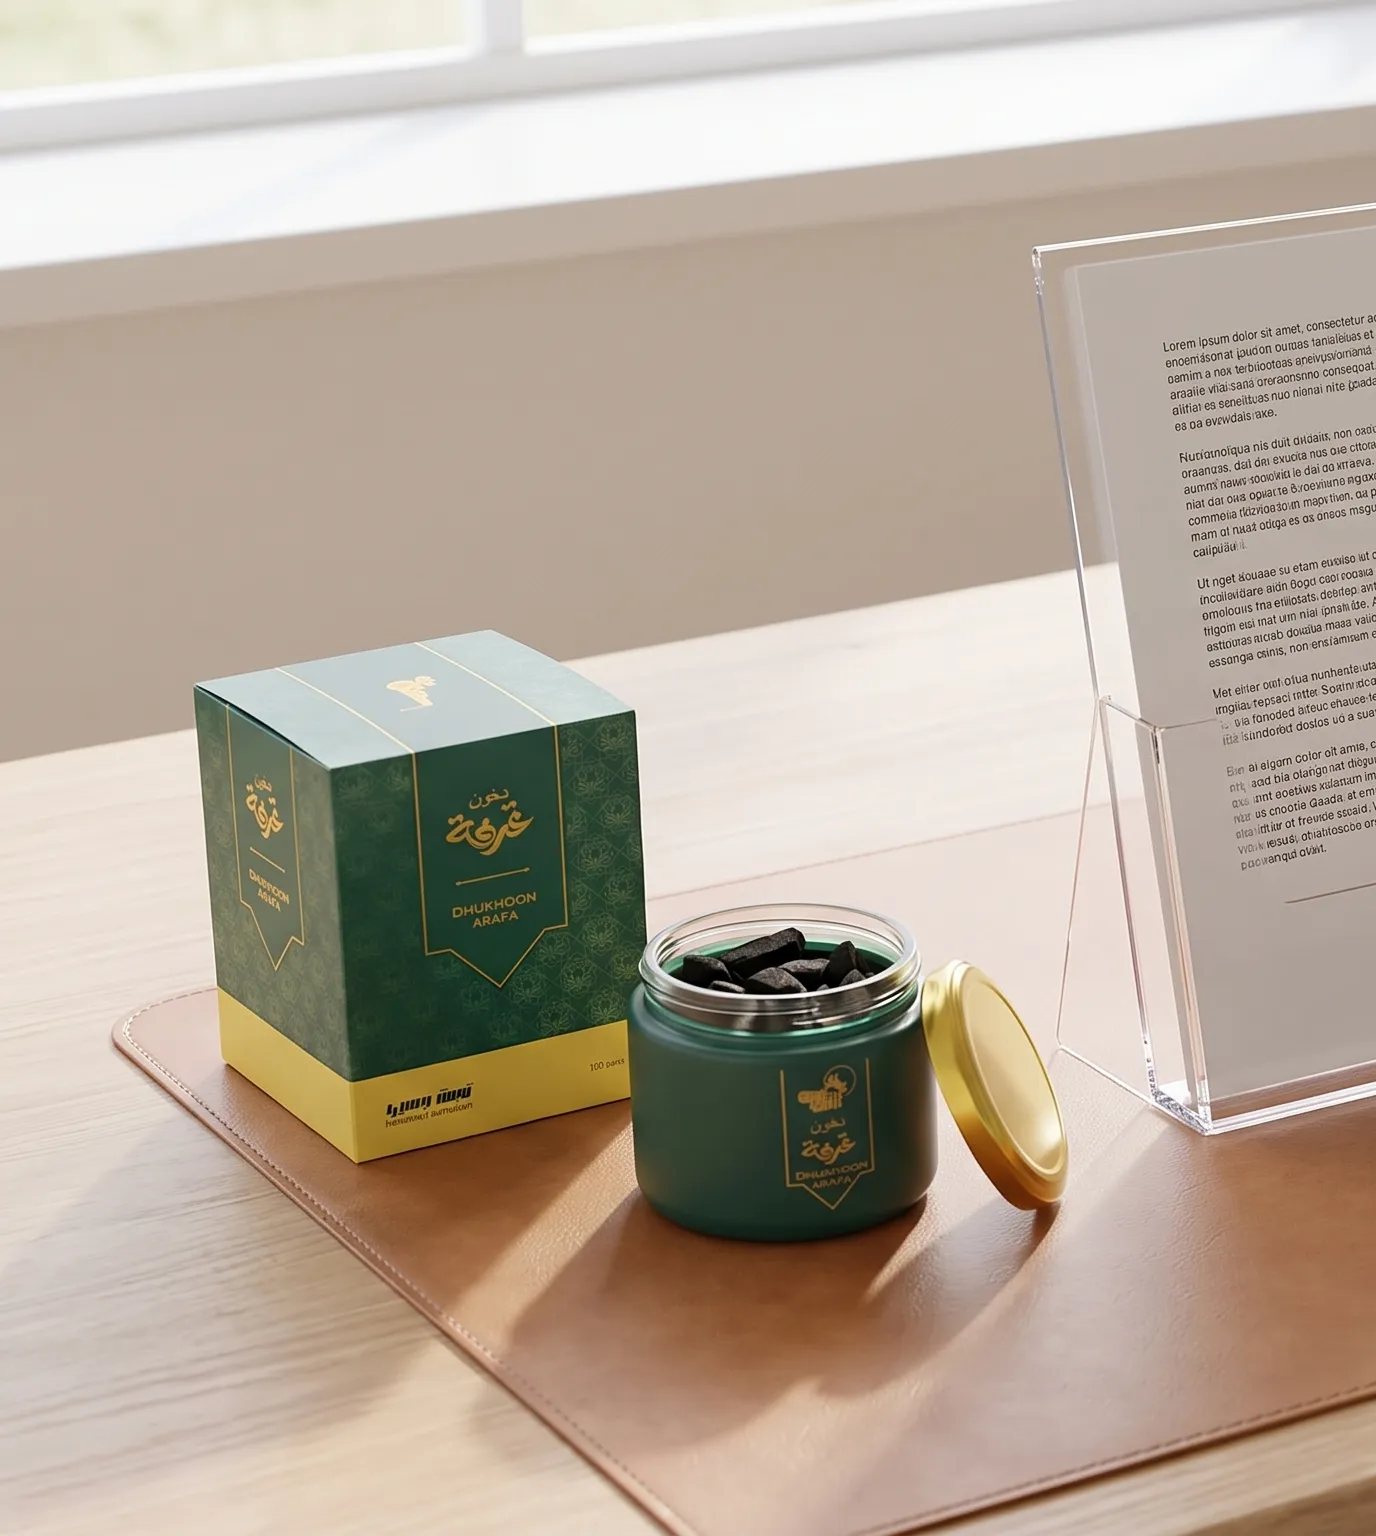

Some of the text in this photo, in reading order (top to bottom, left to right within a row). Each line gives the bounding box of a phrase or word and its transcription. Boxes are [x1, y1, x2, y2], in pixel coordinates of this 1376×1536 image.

[1162, 339, 1197, 353] Lorem
[1231, 330, 1259, 343] dolor
[1260, 326, 1273, 339] sit
[1275, 323, 1305, 337] amet,
[1305, 315, 1366, 333] consectetur
[1363, 329, 1375, 341] et
[1204, 369, 1212, 379] a
[1203, 401, 1217, 412] es
[1252, 440, 1270, 453] nis
[1333, 429, 1353, 440] non
[1309, 448, 1329, 460] nus
[1190, 529, 1218, 543] mam
[1288, 516, 1301, 527] es
[1196, 577, 1211, 590] Ut
[1212, 573, 1237, 588] nget
[1278, 565, 1291, 576] su
[1292, 560, 1319, 574] etam
[1347, 713, 1355, 722] a
[451, 891, 538, 919] DHUKHOON
[472, 910, 520, 929] ARAFA
